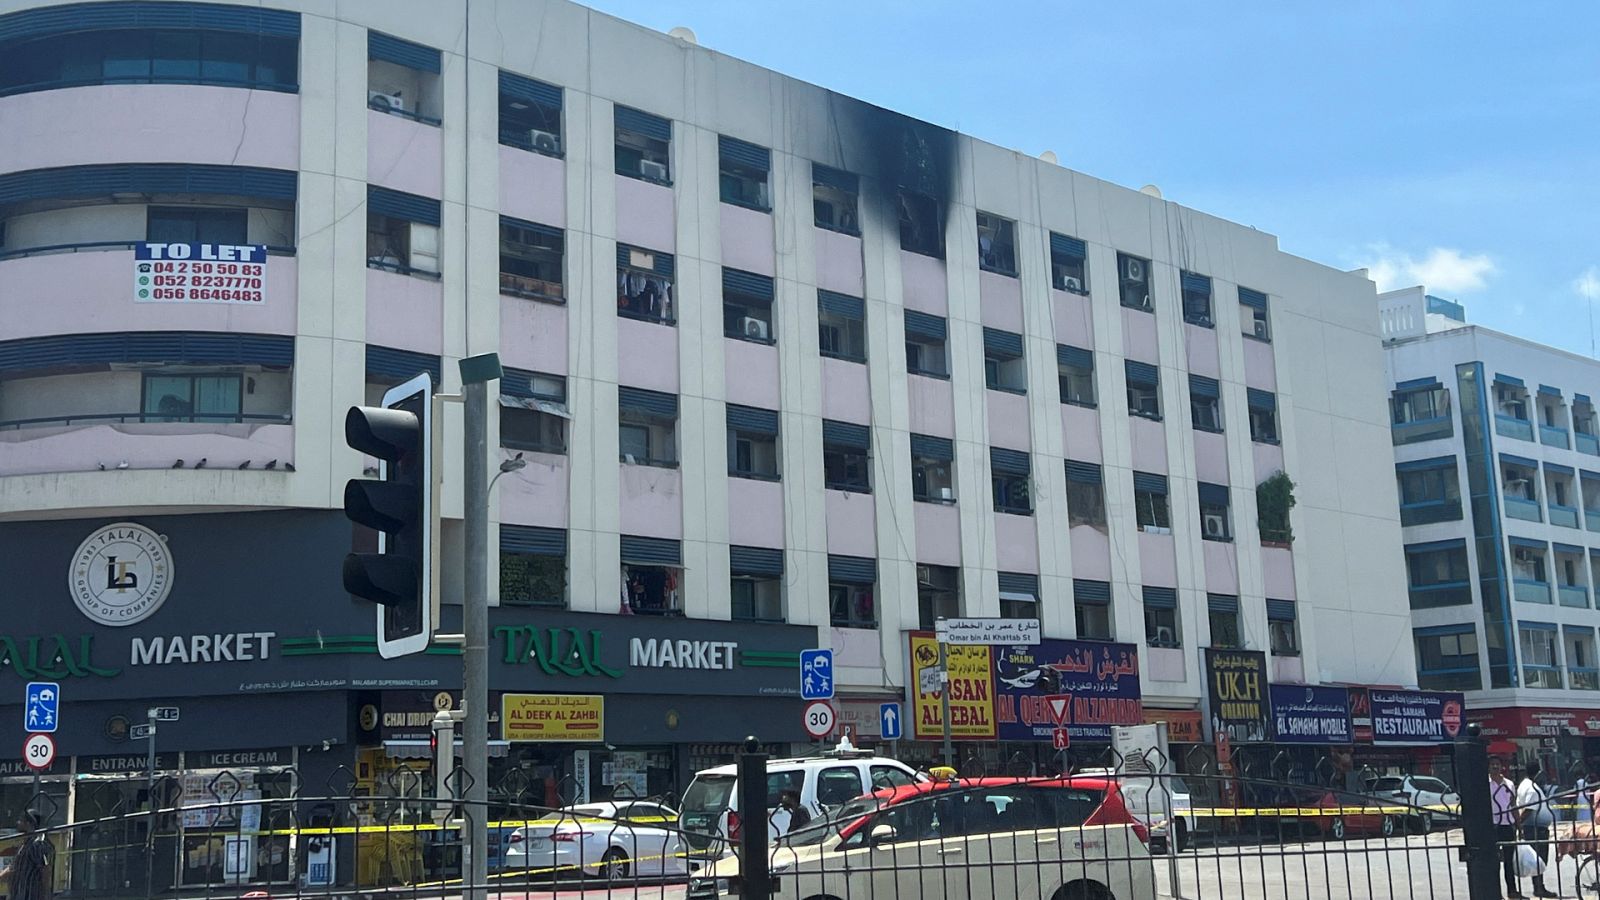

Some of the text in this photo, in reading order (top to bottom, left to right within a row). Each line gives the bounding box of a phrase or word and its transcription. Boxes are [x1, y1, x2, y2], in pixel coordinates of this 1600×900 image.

[146, 243, 256, 261] TO LET
[154, 262, 262, 276] 04 2 50 50 83
[153, 276, 262, 289] 052 8237770
[153, 289, 262, 302] 056 8646483
[80, 530, 162, 566] 1983 TALAL 1983
[78, 574, 163, 616] GROUP OF COMPANIES
[949, 621, 982, 629] الخطاب
[1018, 621, 1038, 631] شارع
[131, 632, 275, 665] MARKET
[494, 624, 737, 678] TALAL MARKET
[1009, 655, 1034, 664] SHARK
[510, 710, 523, 719] AL
[526, 710, 552, 719] DEEK
[555, 710, 567, 720] AL
[570, 710, 599, 720] ZAHBI
[922, 705, 942, 725] AL
[998, 695, 1018, 723] AL
[383, 713, 405, 727] CHAI
[809, 712, 828, 725] 30
[1277, 718, 1287, 735] AL
[1320, 718, 1347, 734] MOBILE
[1375, 717, 1443, 735] RESTAURANT
[31, 744, 48, 757] 30
[211, 752, 278, 764] ICE CREAM
